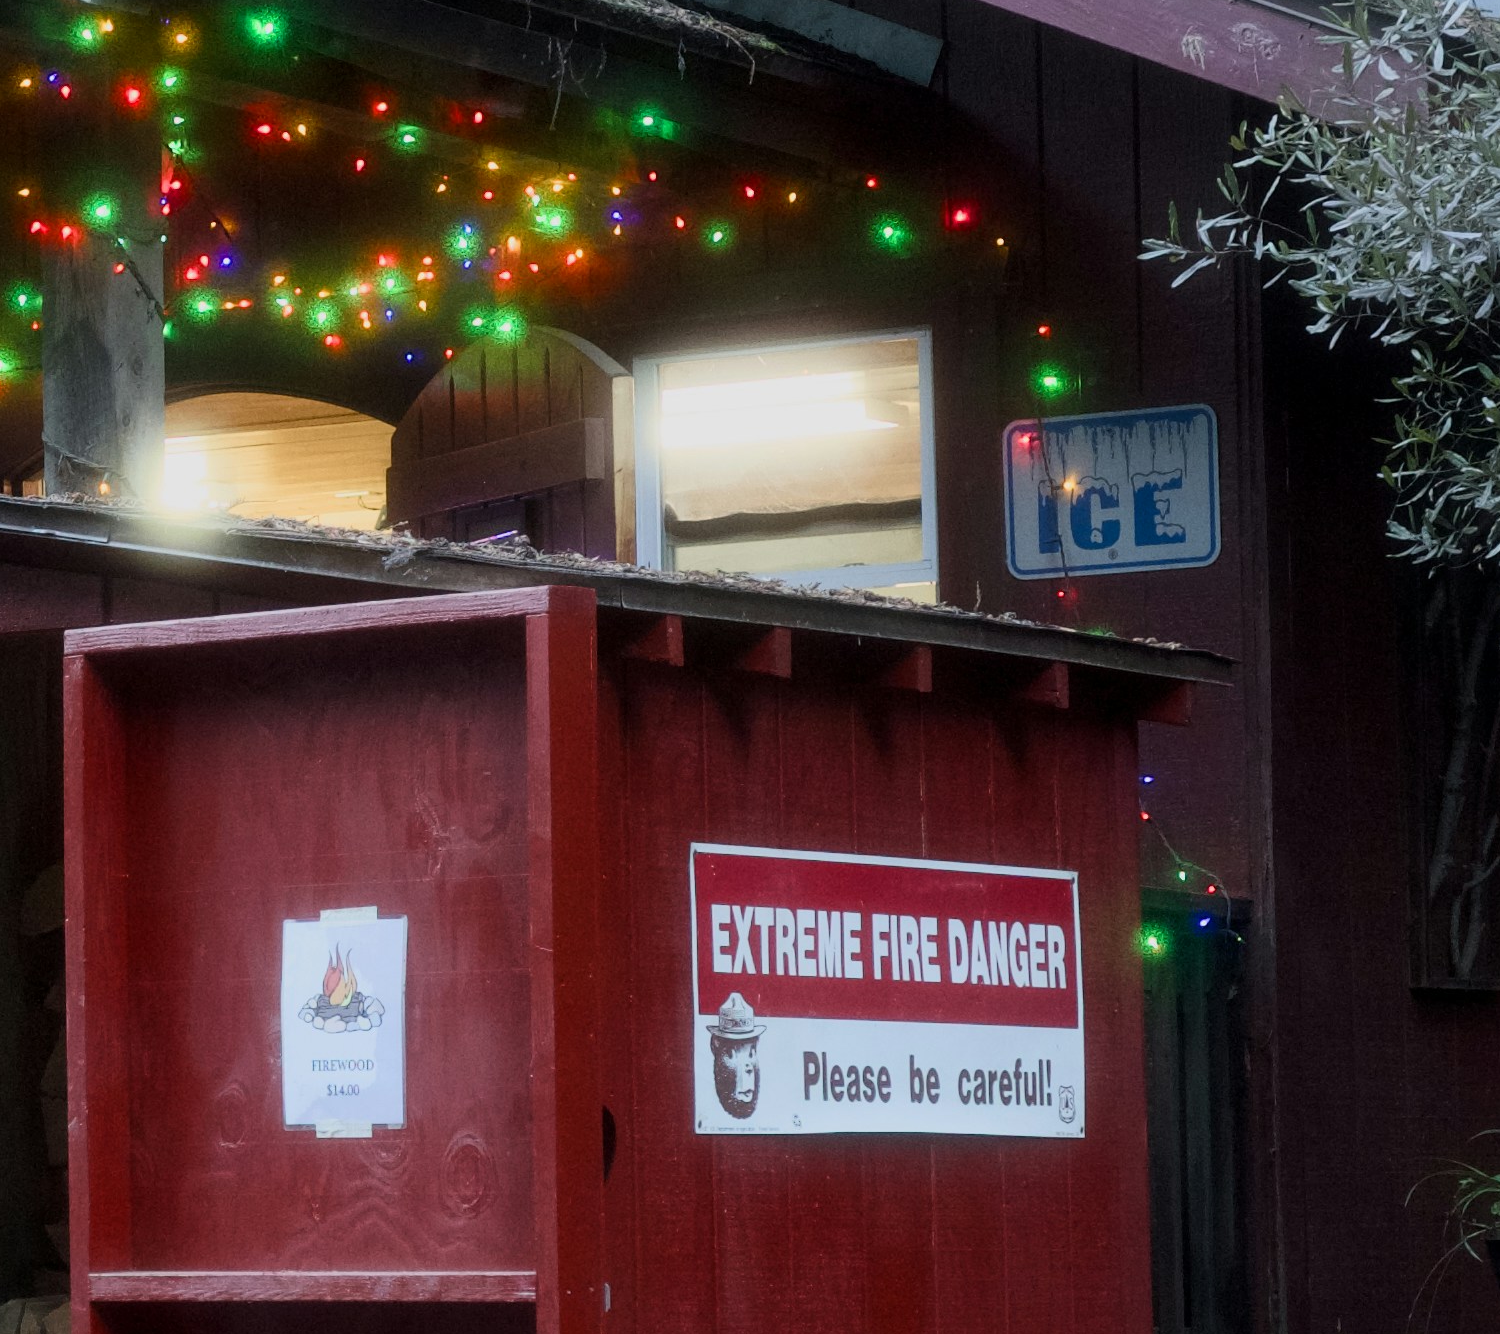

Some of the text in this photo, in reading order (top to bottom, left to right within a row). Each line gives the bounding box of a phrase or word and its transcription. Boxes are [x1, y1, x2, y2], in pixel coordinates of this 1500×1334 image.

[1037, 468, 1188, 554] ICE
[710, 903, 1068, 990] EXTREME FIRE DANGER
[311, 1058, 375, 1072] FIREWOOD
[326, 1083, 360, 1097] $14.00
[802, 1050, 892, 1103] Please
[909, 1054, 941, 1104] be
[958, 1058, 1053, 1107] careful!
